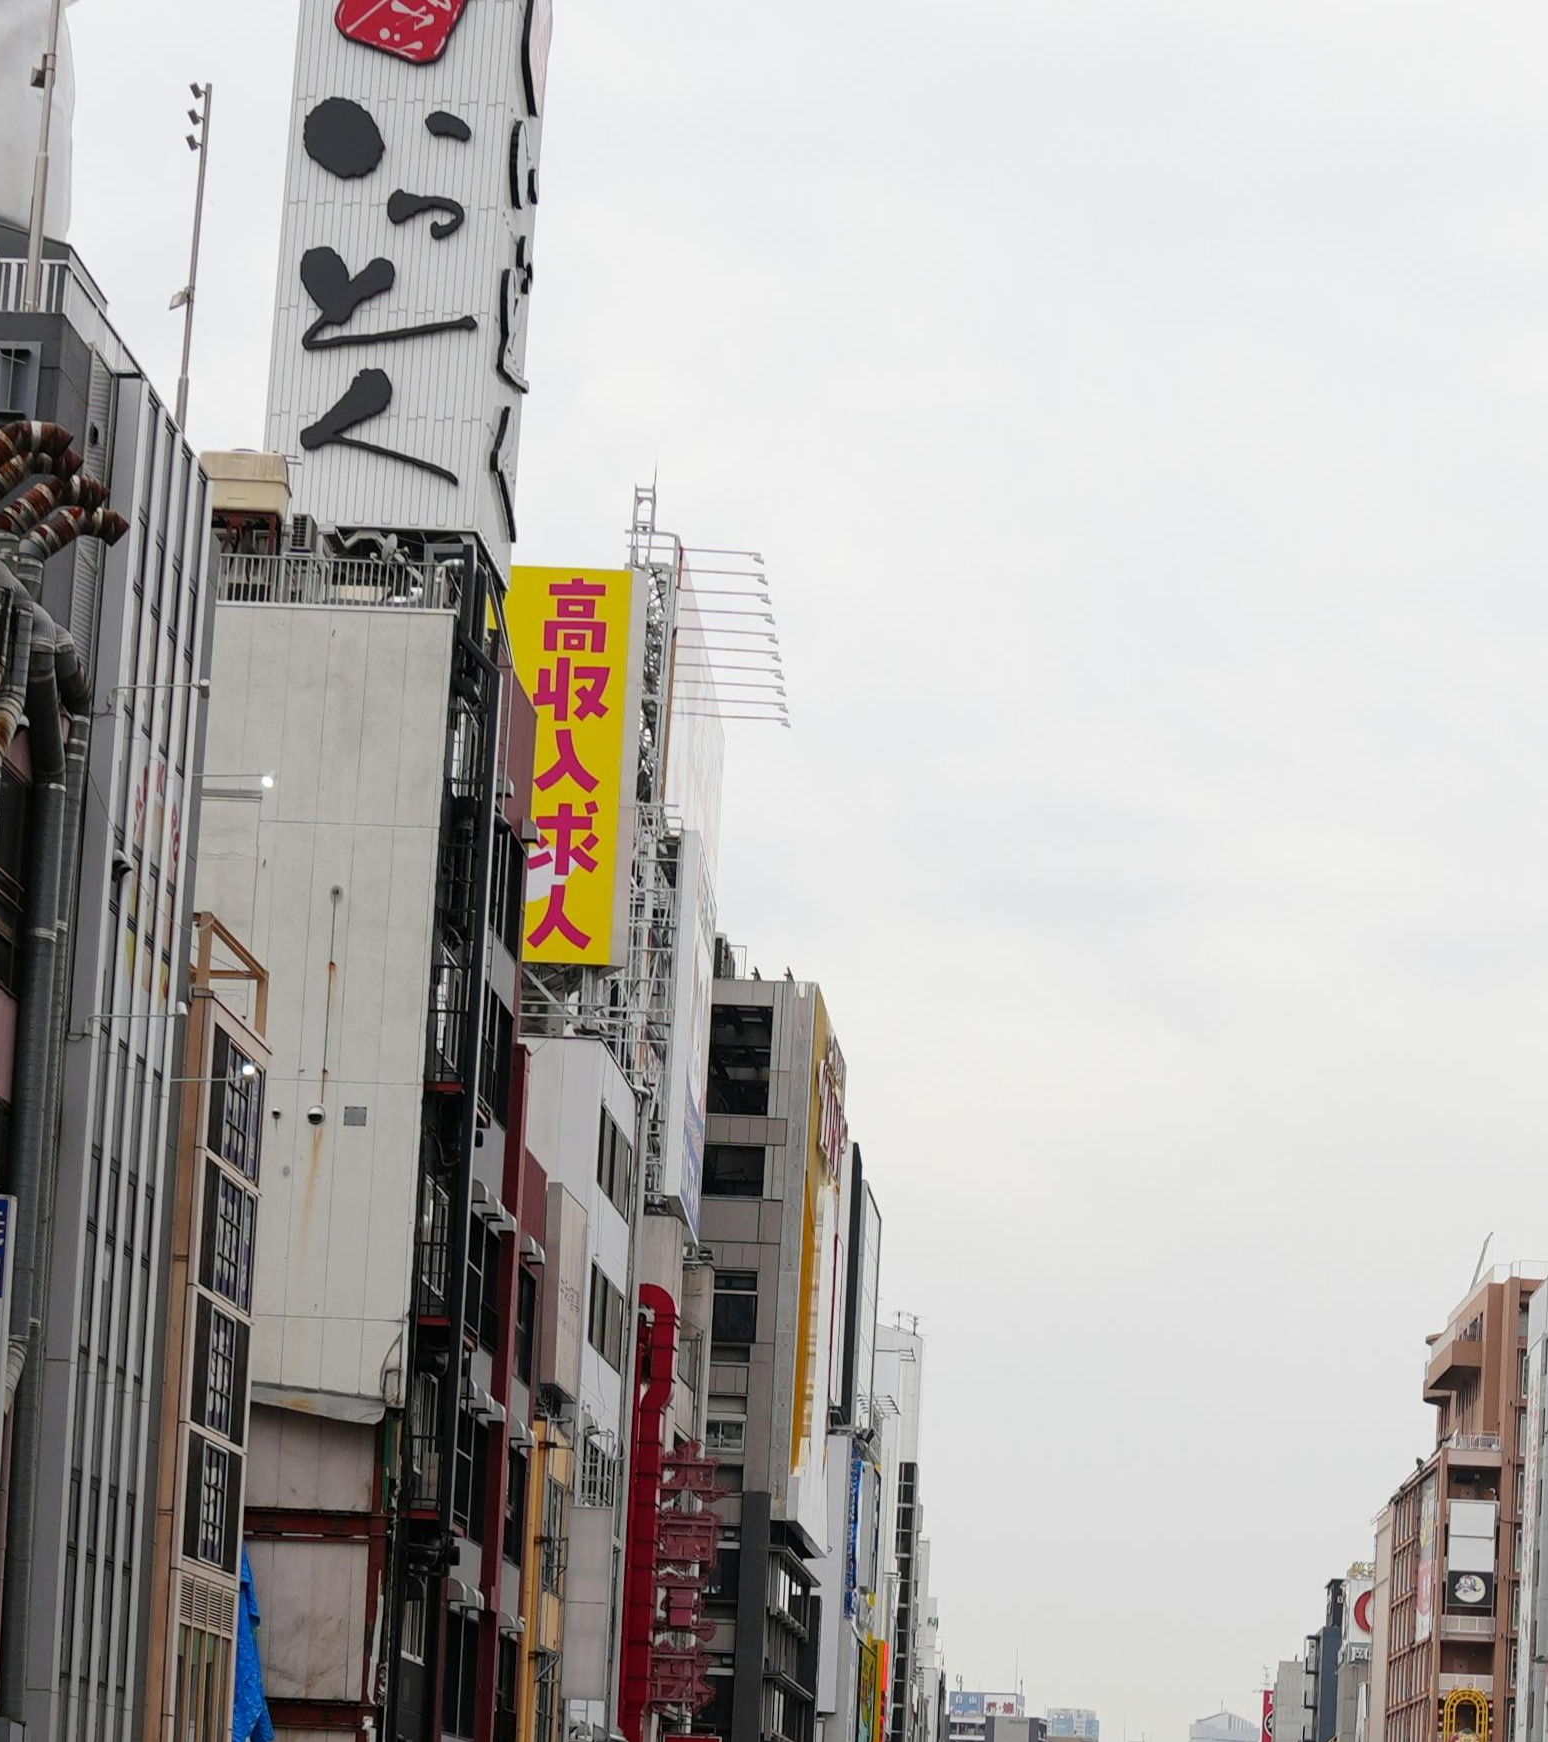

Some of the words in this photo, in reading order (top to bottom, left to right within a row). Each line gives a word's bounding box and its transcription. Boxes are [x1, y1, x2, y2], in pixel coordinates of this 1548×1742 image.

[526, 578, 612, 951] 高収入求人
